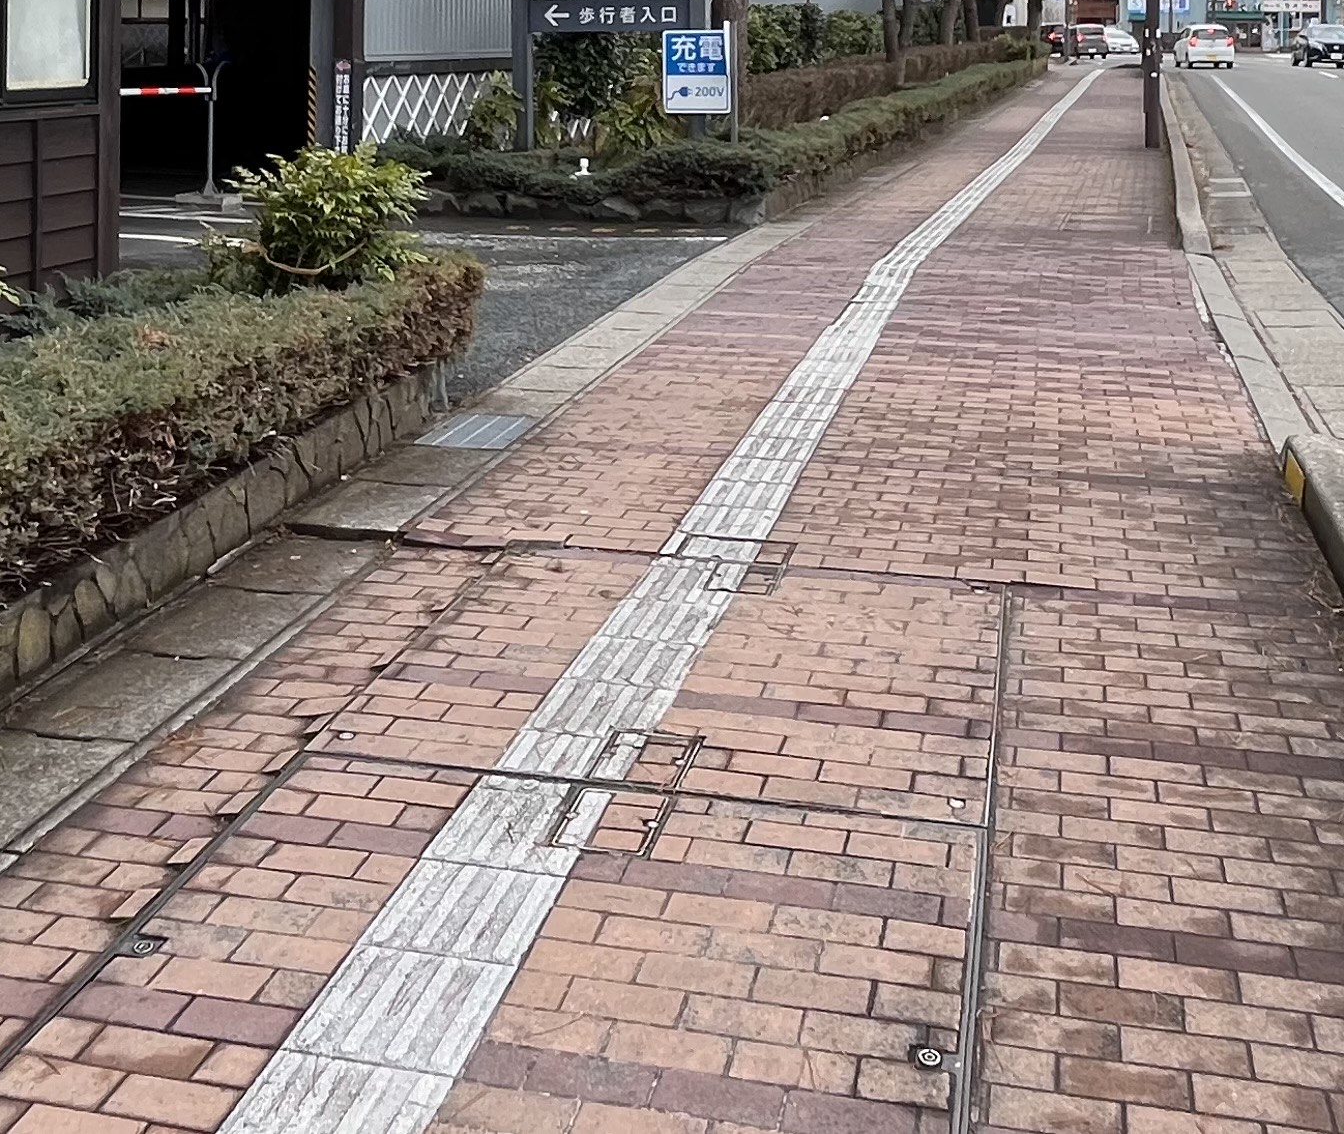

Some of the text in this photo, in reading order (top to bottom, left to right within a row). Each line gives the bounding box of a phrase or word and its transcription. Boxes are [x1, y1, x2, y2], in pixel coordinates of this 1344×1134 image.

[579, 6, 677, 25] 歩行者入口
[671, 34, 723, 61] 充電
[676, 61, 716, 73] できます
[694, 85, 725, 97] 200V
